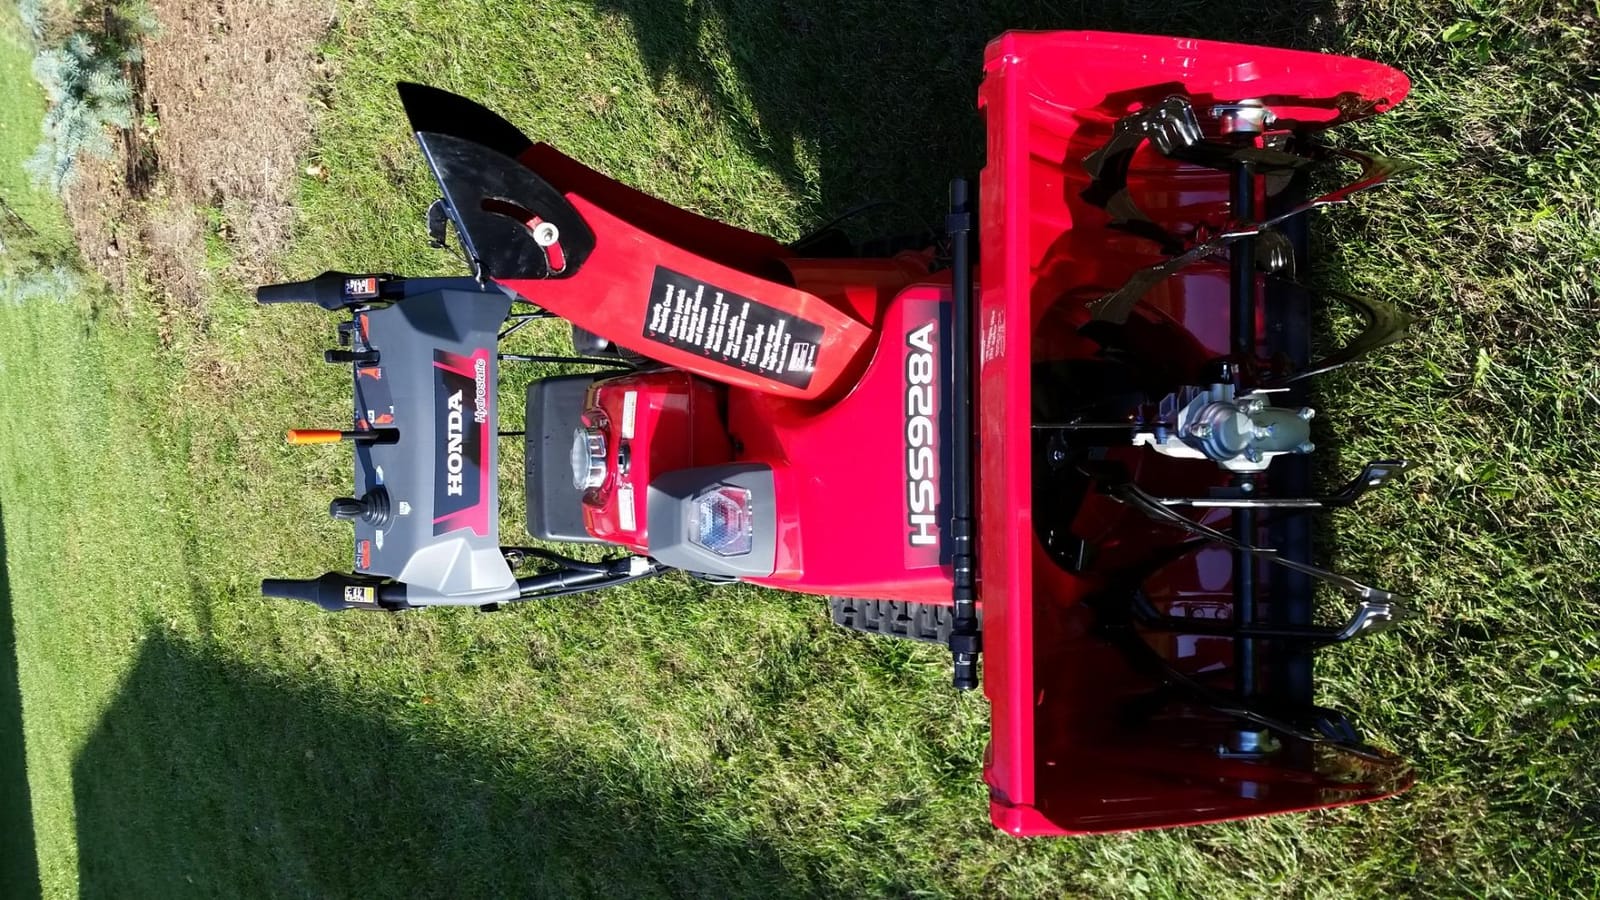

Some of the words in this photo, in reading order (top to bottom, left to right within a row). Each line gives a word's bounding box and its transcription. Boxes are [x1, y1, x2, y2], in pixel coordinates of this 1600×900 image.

[657, 307, 671, 334] Steering
[662, 284, 674, 307] Control
[475, 359, 487, 423] Hydrostatic
[448, 390, 463, 496] HONDA
[907, 322, 937, 545] HSS928A
